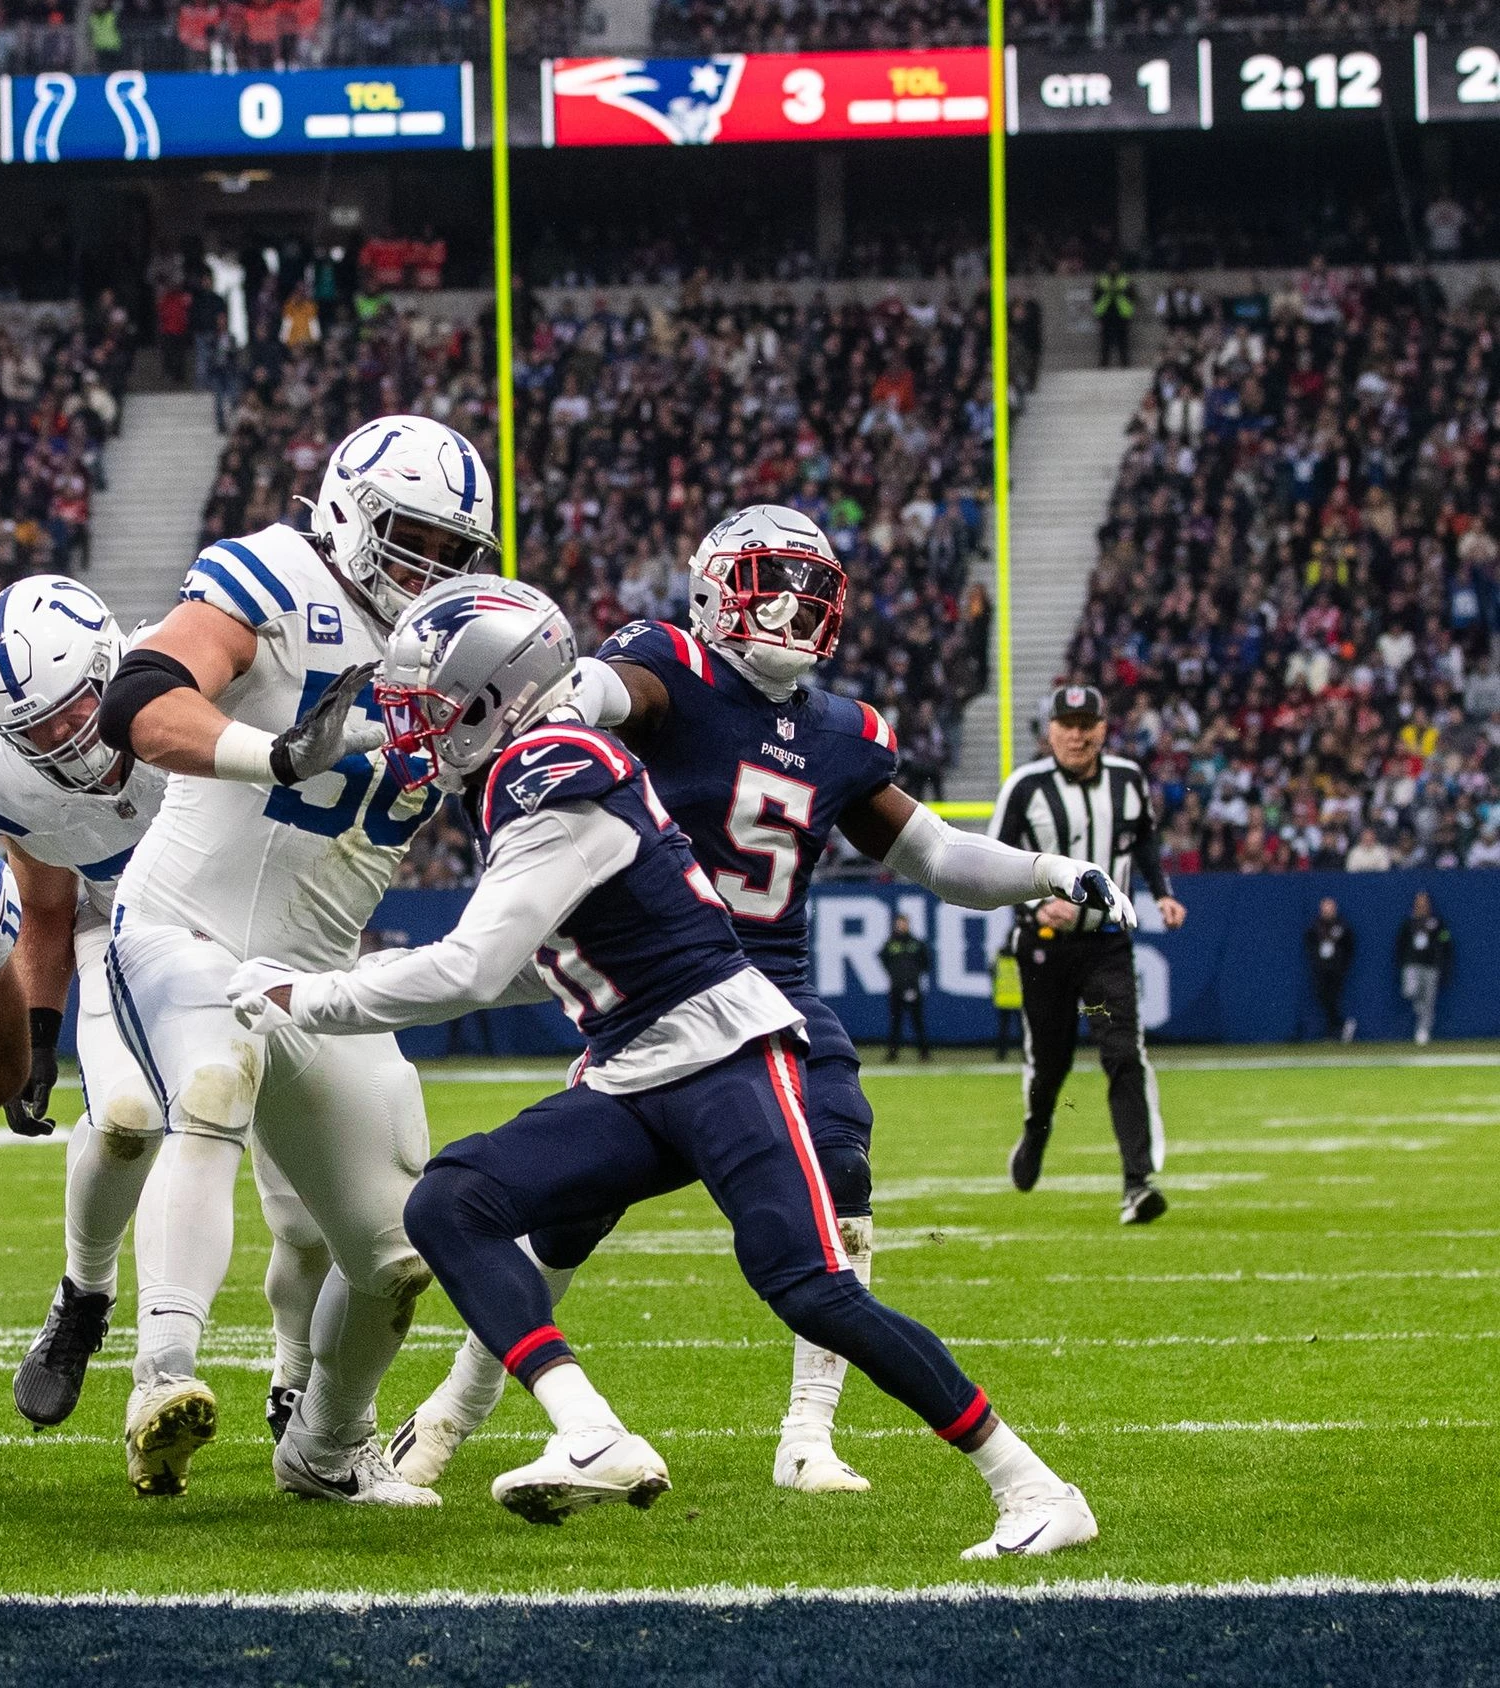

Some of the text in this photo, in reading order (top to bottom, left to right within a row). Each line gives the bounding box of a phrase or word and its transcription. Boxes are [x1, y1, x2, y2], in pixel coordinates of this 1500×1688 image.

[888, 66, 947, 97] TOL
[1040, 58, 1171, 115] QTR 1
[1239, 51, 1382, 112] 2:12
[1456, 46, 1500, 102] 2
[238, 82, 284, 139] 0
[344, 81, 404, 111] TOL
[781, 67, 826, 125] 3
[453, 511, 477, 526] COLTS
[311, 605, 340, 634] C
[11, 700, 38, 717] COLTS
[761, 742, 807, 770] PATRIOTS
[713, 759, 818, 923] 5
